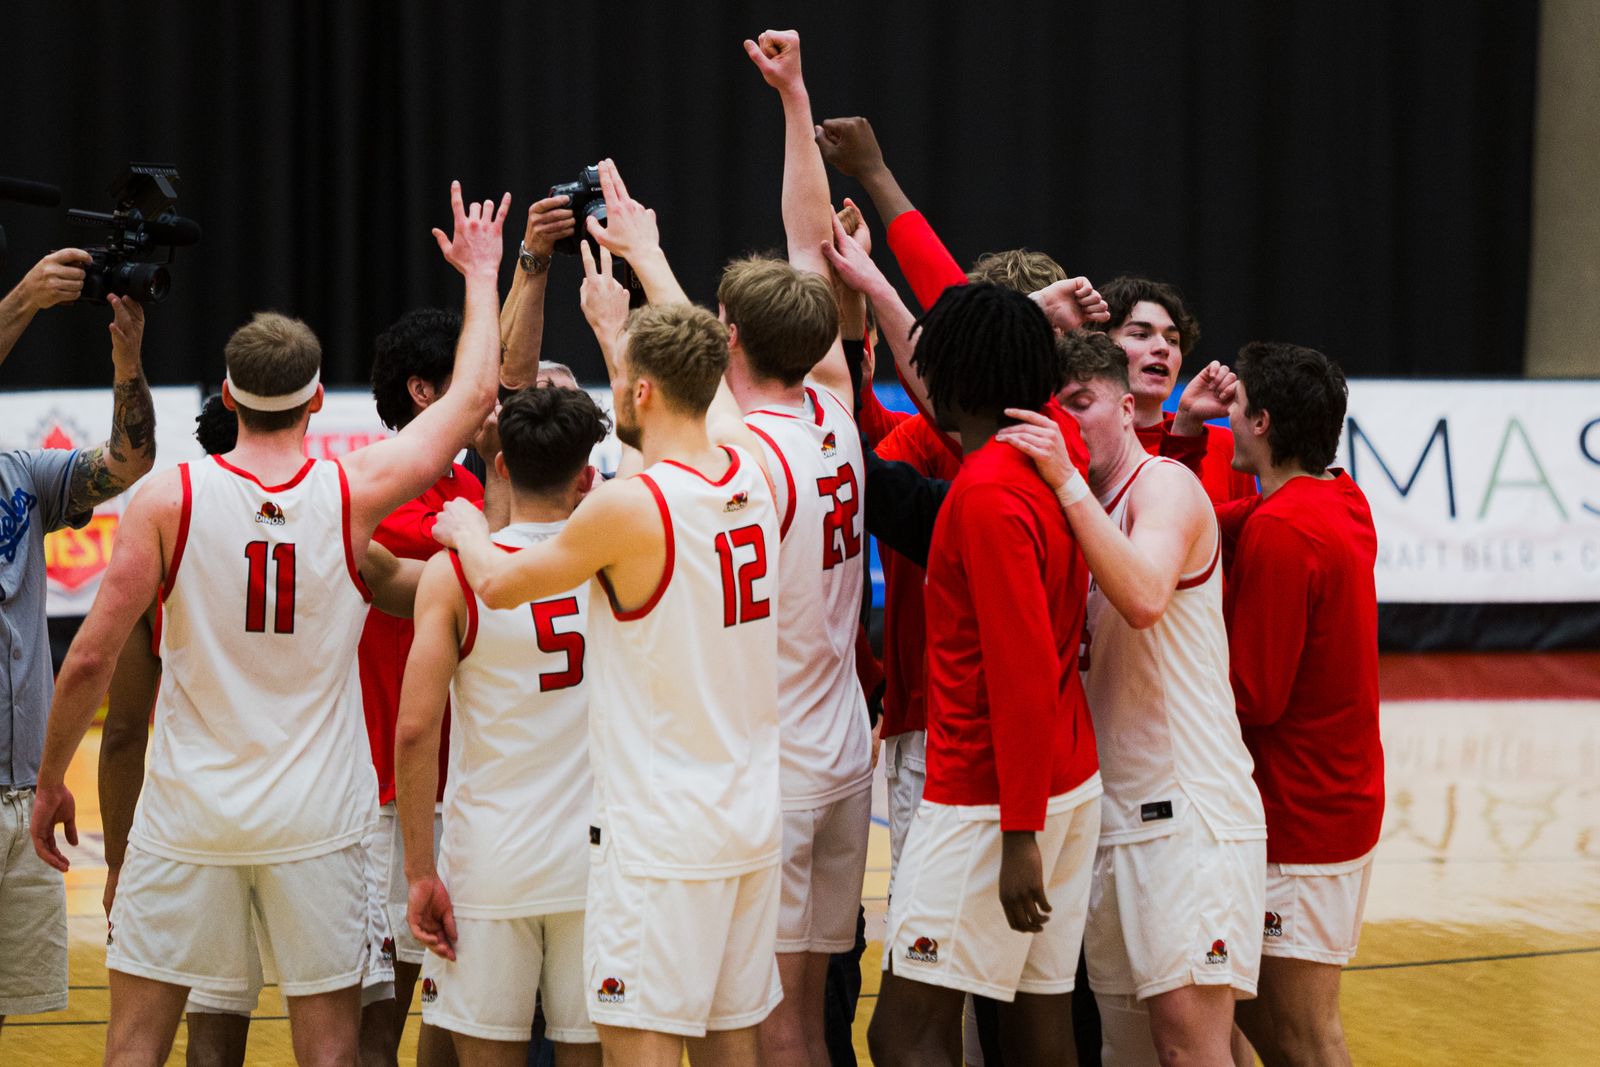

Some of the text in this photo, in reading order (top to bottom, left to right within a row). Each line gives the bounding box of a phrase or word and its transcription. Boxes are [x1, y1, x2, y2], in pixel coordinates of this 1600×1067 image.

[255, 513, 286, 526] DINOS
[816, 462, 861, 572] 22
[245, 540, 296, 635] 11
[714, 523, 771, 628] 12
[530, 595, 586, 693] 5
[905, 951, 938, 963] DINOS
